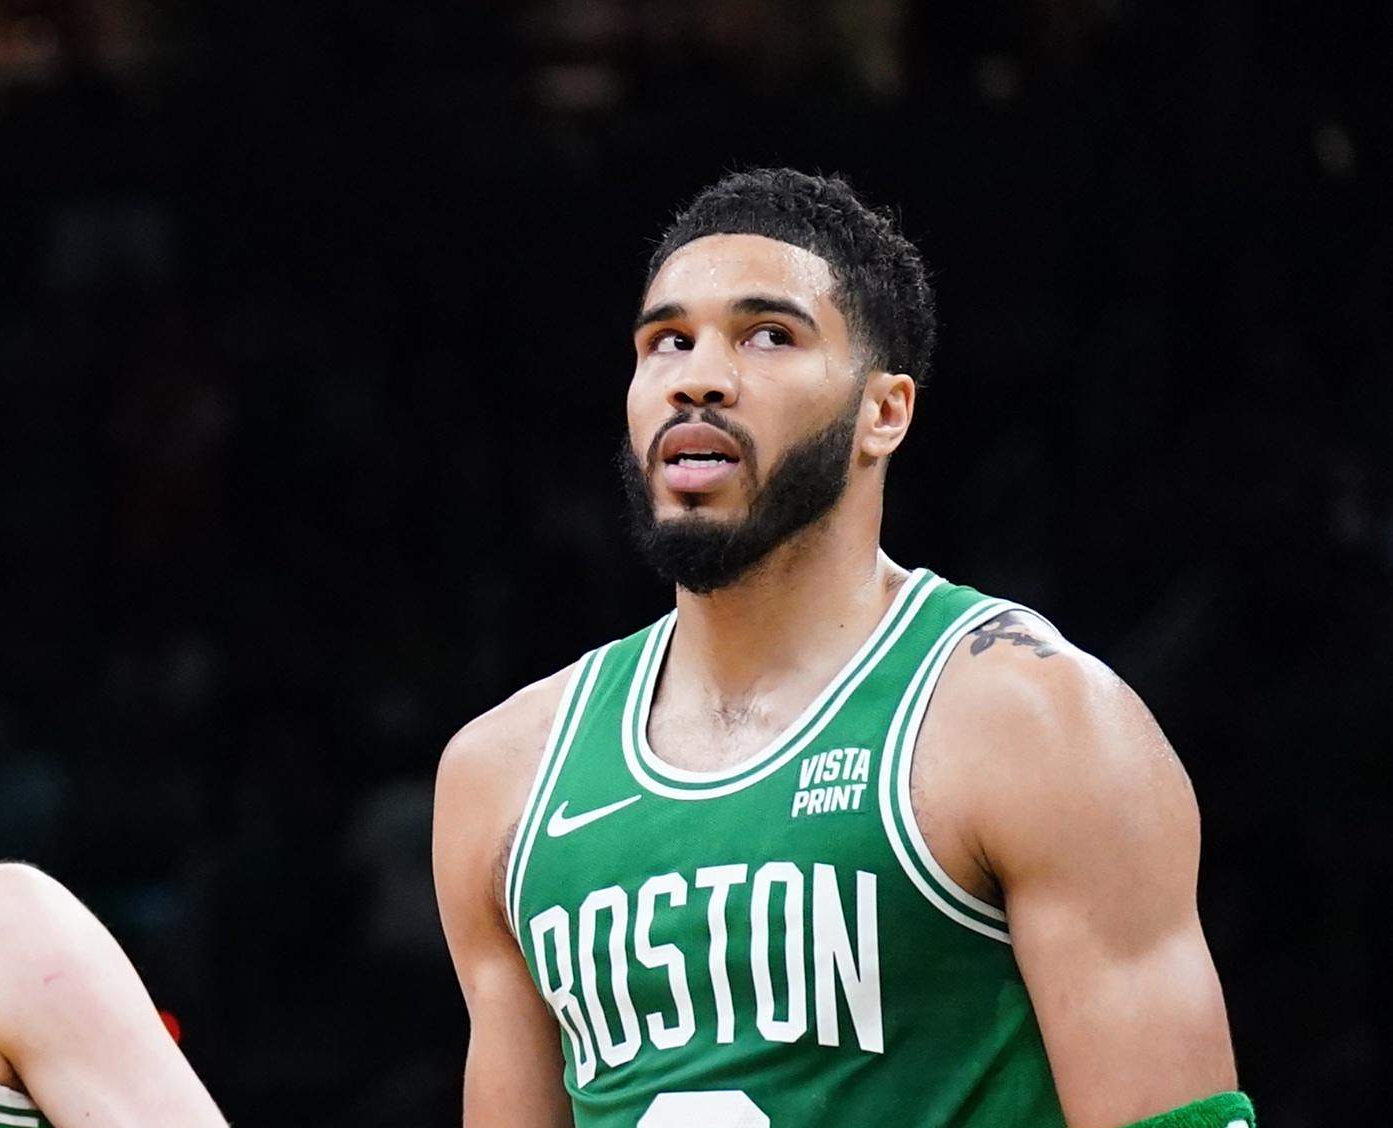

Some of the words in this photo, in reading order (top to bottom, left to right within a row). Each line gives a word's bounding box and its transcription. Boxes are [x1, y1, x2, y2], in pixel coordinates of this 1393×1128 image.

[799, 747, 871, 790] VISTA
[791, 783, 867, 818] PRINT
[529, 861, 884, 1089] BOSTON
